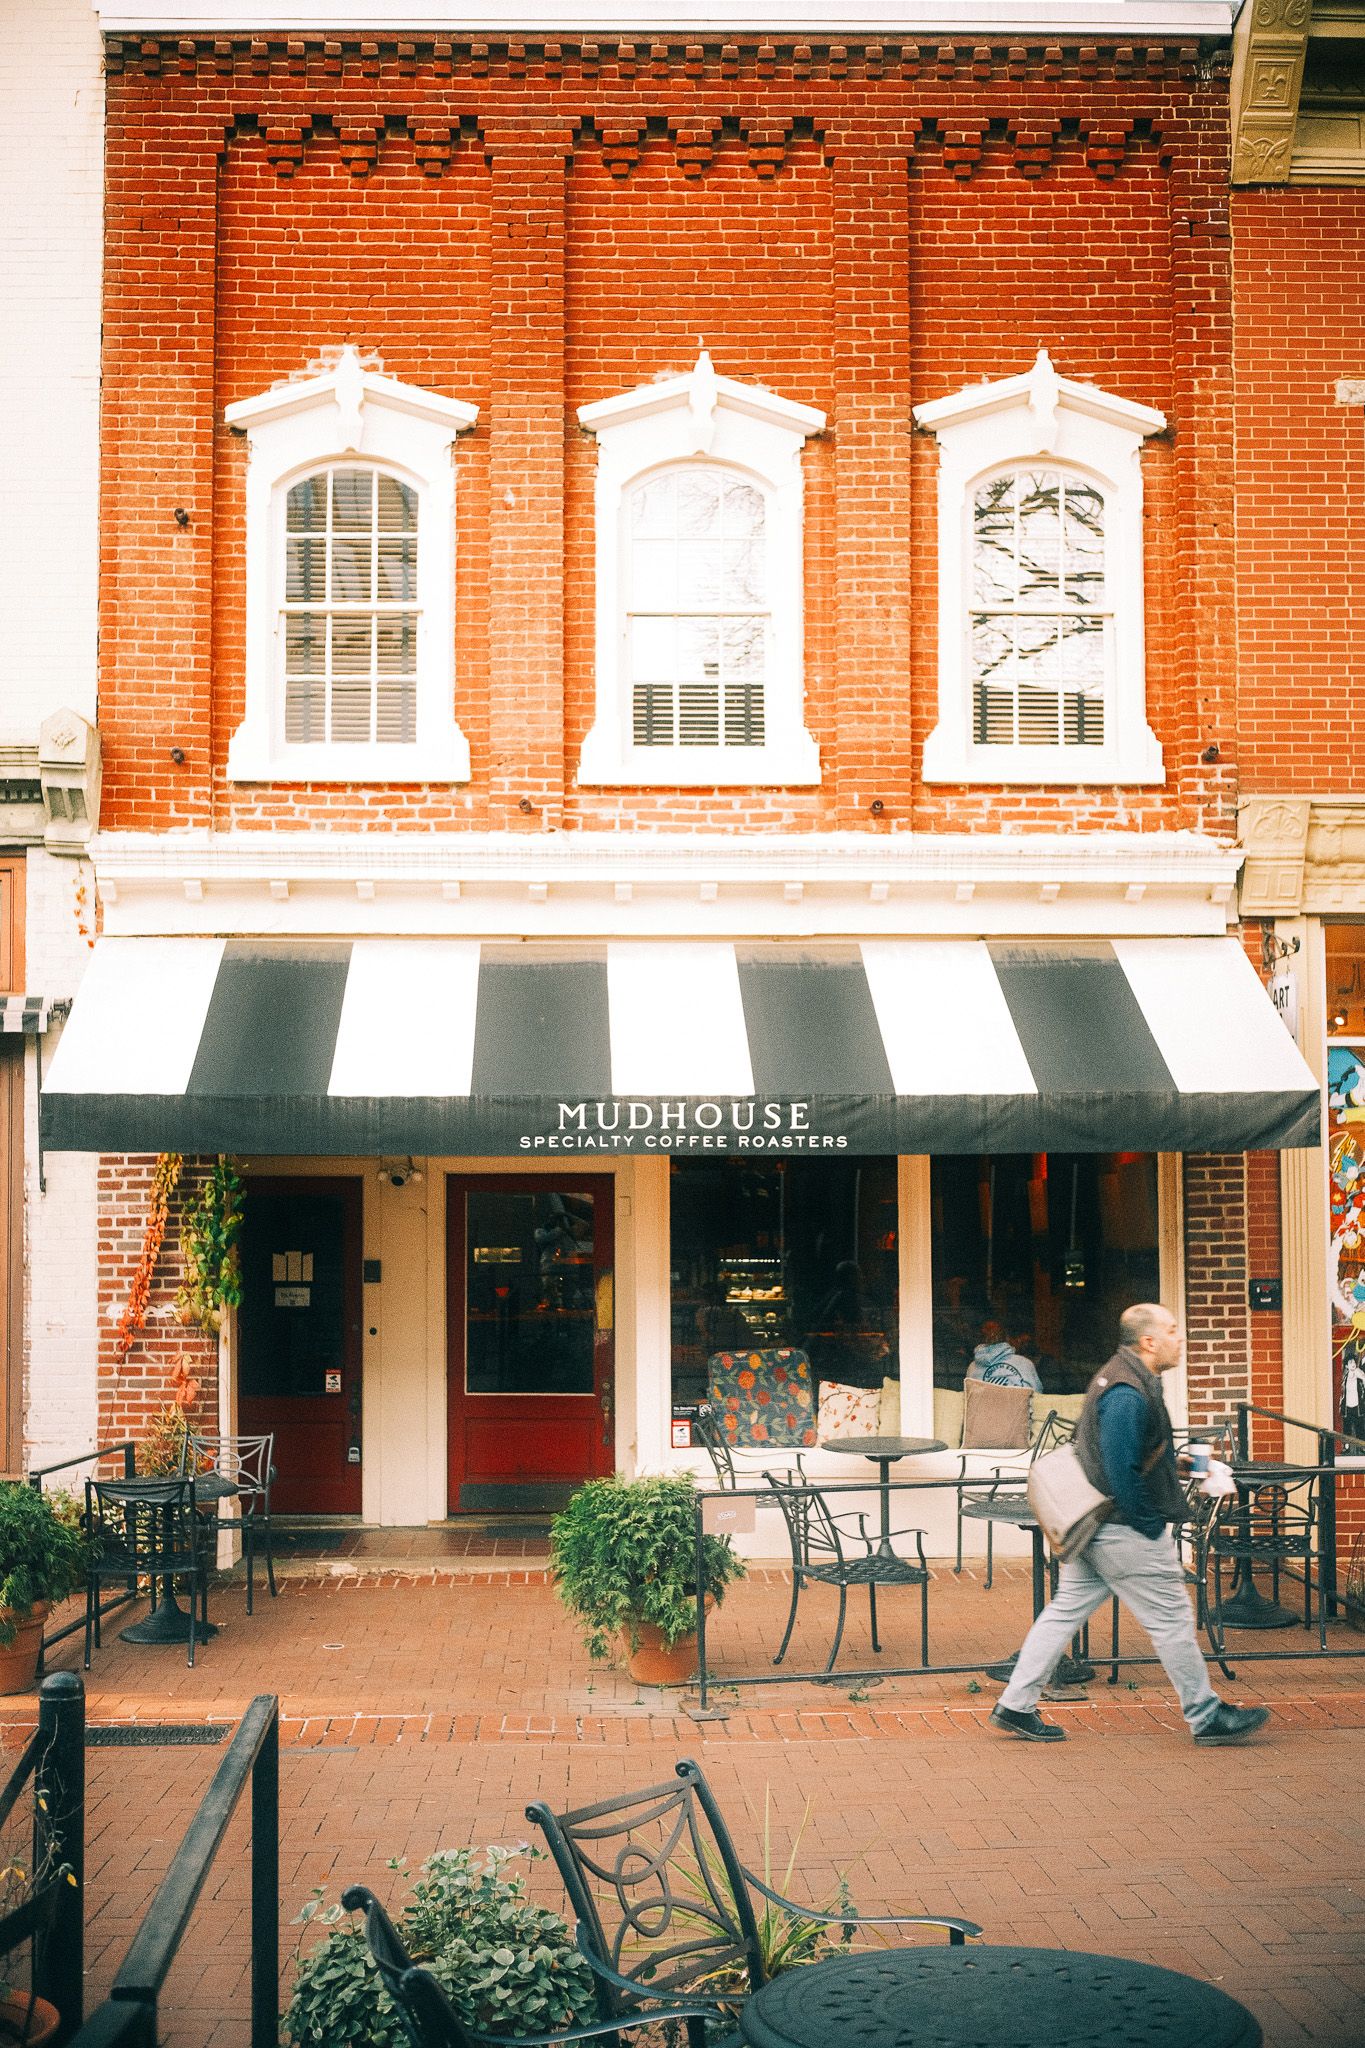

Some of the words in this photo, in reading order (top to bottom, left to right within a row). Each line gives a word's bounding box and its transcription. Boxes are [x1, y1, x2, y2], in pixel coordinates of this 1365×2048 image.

[1273, 985, 1290, 1010] ART
[557, 1102, 810, 1130] MUDHOUSE
[519, 1135, 635, 1149] SPECIALTY
[644, 1135, 728, 1148] COFFEE
[738, 1135, 848, 1148] ROASTERS
